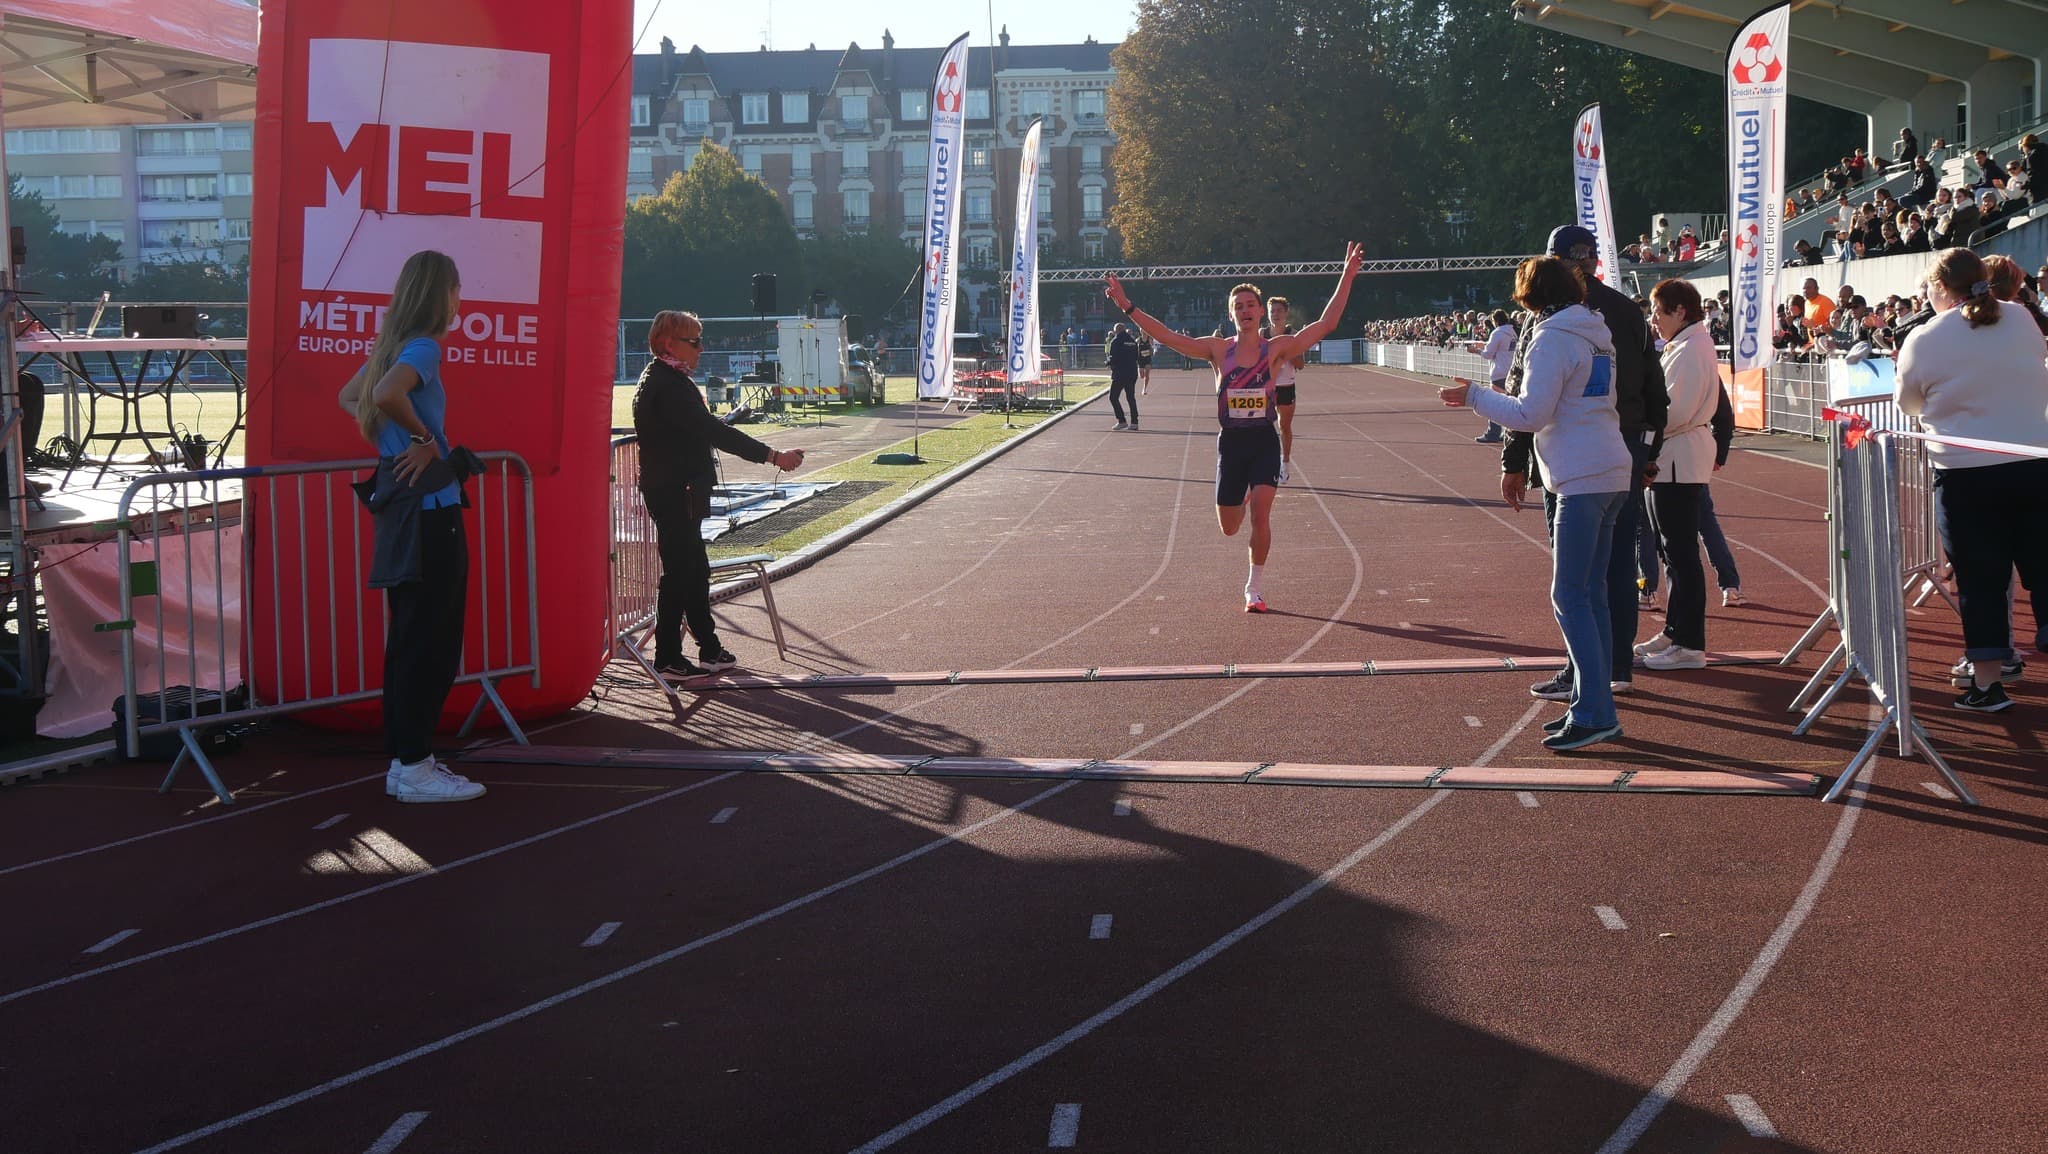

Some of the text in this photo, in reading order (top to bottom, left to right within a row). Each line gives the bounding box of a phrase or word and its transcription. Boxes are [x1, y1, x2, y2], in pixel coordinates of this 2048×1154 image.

[303, 122, 545, 222] MEL
[1736, 110, 1760, 220] Mutuel
[1579, 176, 1599, 250] utuel
[1765, 203, 1777, 276] Nord Europe
[922, 288, 937, 385] Crédit
[930, 138, 949, 248] Mutuel
[940, 234, 952, 306] Nord Europe
[1611, 275, 1619, 290] ord
[300, 296, 538, 344] MÉTOLE
[1010, 303, 1025, 373] Crédit
[1740, 262, 1758, 359] Crédit
[447, 347, 476, 364] DE
[483, 350, 537, 367] LILLE
[1230, 397, 1264, 409] 1205
